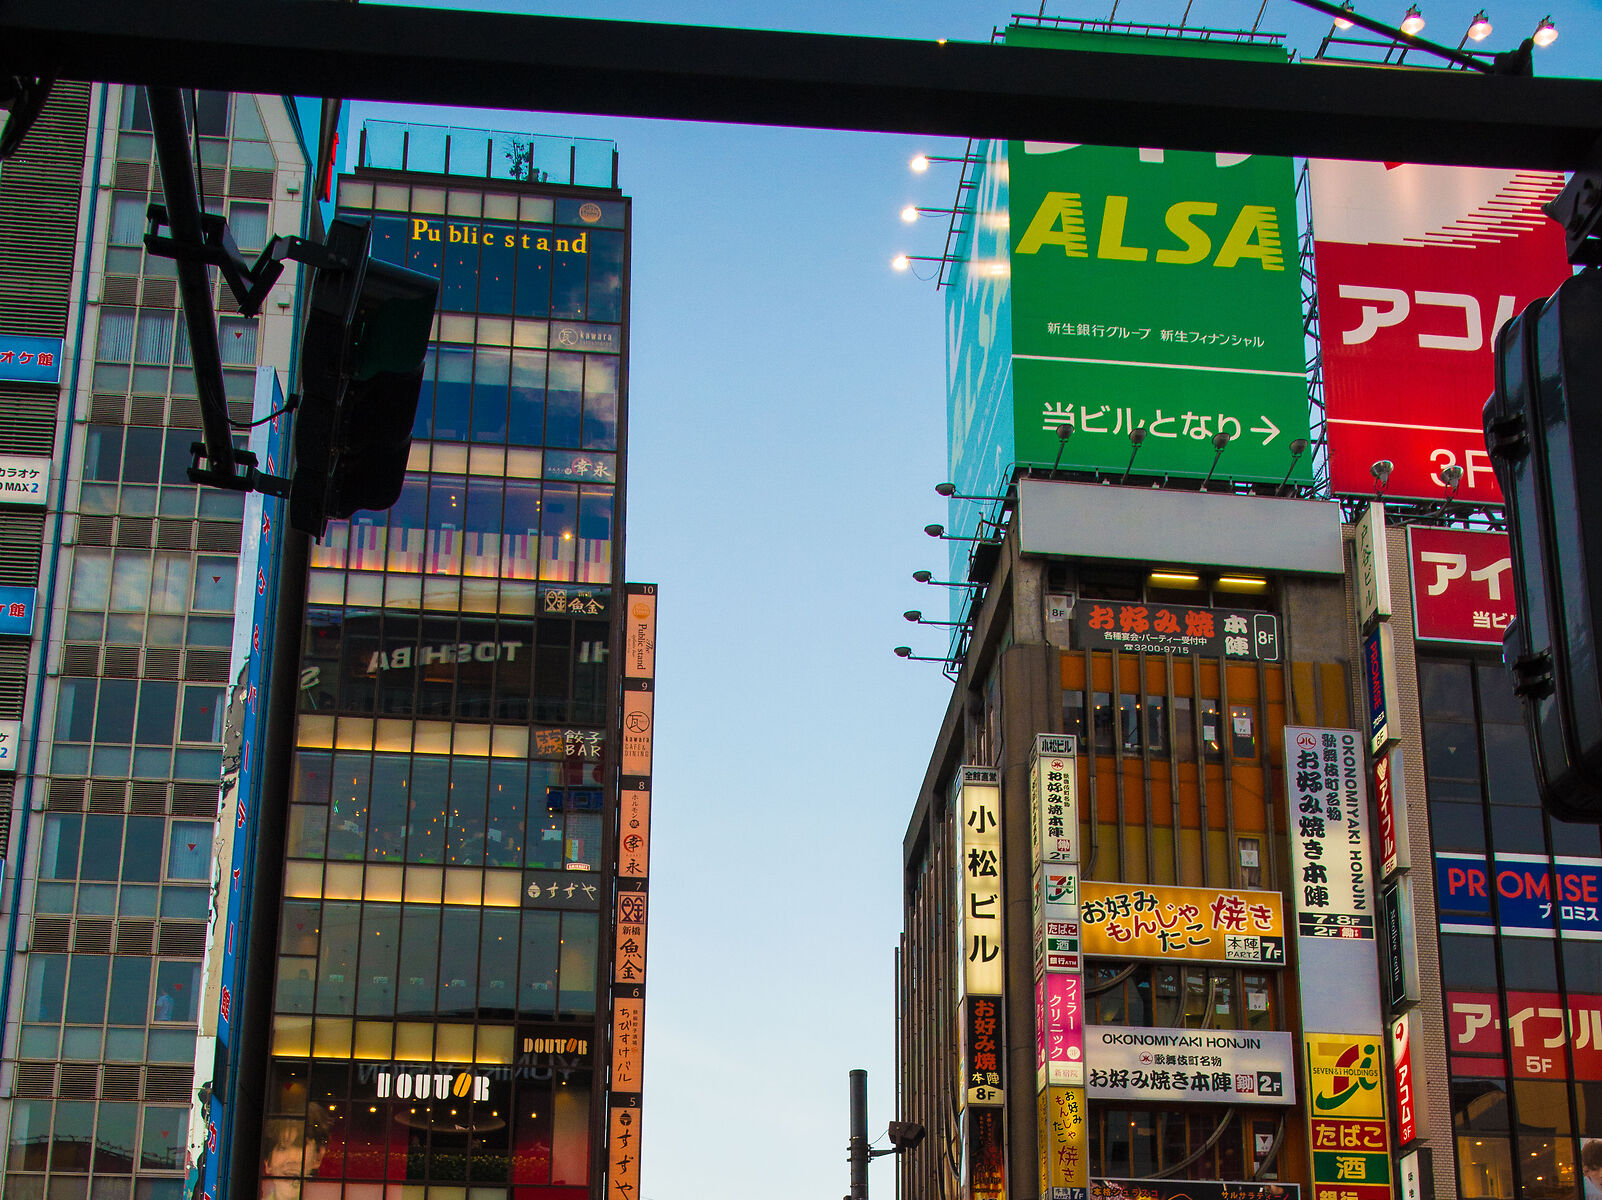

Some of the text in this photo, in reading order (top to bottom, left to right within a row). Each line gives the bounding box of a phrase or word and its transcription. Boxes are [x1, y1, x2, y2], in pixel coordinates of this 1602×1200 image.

[412, 219, 587, 253] Public stand
[1015, 191, 1285, 271] ALSA
[1048, 322, 1265, 349] 新生銀行グループ 新生フィナンシャル
[0, 351, 53, 366] オケ館
[1042, 401, 1242, 442] 当ビルとなり
[643, 586, 654, 594] 10
[1088, 605, 1215, 638] お好み焼
[1223, 614, 1250, 657] 本陣
[1258, 630, 1275, 646] 8F
[637, 624, 648, 671] Public stand
[1370, 641, 1382, 711] PROMISE
[564, 730, 601, 746] 餃子
[1041, 738, 1072, 754] 小松ビル
[564, 744, 602, 758] BAR
[639, 782, 644, 790] 8
[1321, 733, 1342, 822] 歌舞伎町名物
[1047, 770, 1064, 838] お好み焼本陣
[1296, 750, 1330, 909] お好み焼き本陣
[1341, 733, 1366, 911] OKONOMIYAKI HONJIN
[1379, 778, 1396, 859] アイフル
[1049, 852, 1070, 860] 2F
[546, 882, 597, 901] すずや
[967, 805, 1000, 963] 小松ビル
[1448, 868, 1598, 903] PROMISE
[1081, 890, 1158, 925] お好み
[1210, 893, 1274, 932] 焼き
[1538, 903, 1600, 922] プロミス
[622, 926, 640, 936] 新橋
[1048, 924, 1078, 936] たばこ
[1106, 902, 1200, 944] もんじゃ
[1313, 926, 1338, 937] 2F
[1056, 940, 1070, 951] 酒
[1156, 924, 1212, 953] たこ
[1226, 937, 1259, 950] 本陣
[620, 938, 643, 980] 魚金
[1050, 956, 1077, 966] 銀行ATM
[1262, 942, 1282, 959] 7F
[632, 988, 639, 997] 6
[1066, 980, 1077, 1030] フィラー
[974, 1000, 997, 1071] お好み焼
[1050, 994, 1062, 1059] クリニック
[1453, 1003, 1602, 1050] アイフル
[524, 1038, 588, 1055] DOUTOR
[1102, 1033, 1262, 1050] OKONOMIYAKI HONJIN
[1153, 1053, 1222, 1068] 歌舞伎町名物
[1526, 1056, 1552, 1073] 5F
[972, 1072, 1000, 1084] 本陣
[1088, 1068, 1233, 1093] お好み焼き本陣
[1260, 1075, 1282, 1092] 2F
[1342, 1068, 1378, 1078] HOLDINGS
[376, 1072, 490, 1101] DOUTOR
[976, 1088, 996, 1100] 8F
[1398, 1064, 1411, 1124] アコム
[630, 1098, 636, 1106] 5
[1065, 1090, 1082, 1124] お好み
[1055, 1095, 1077, 1140] もんじゃ
[1052, 1121, 1067, 1143] たこ
[1315, 1122, 1384, 1148] たばこ
[1402, 1126, 1411, 1141] 3F
[1058, 1146, 1079, 1183] 焼き
[1336, 1156, 1366, 1180] 酒
[1072, 1188, 1084, 1200] 7F
[1093, 1186, 1159, 1198] 本格シュラスコ
[1221, 1190, 1289, 1200] サルサラティーノ
